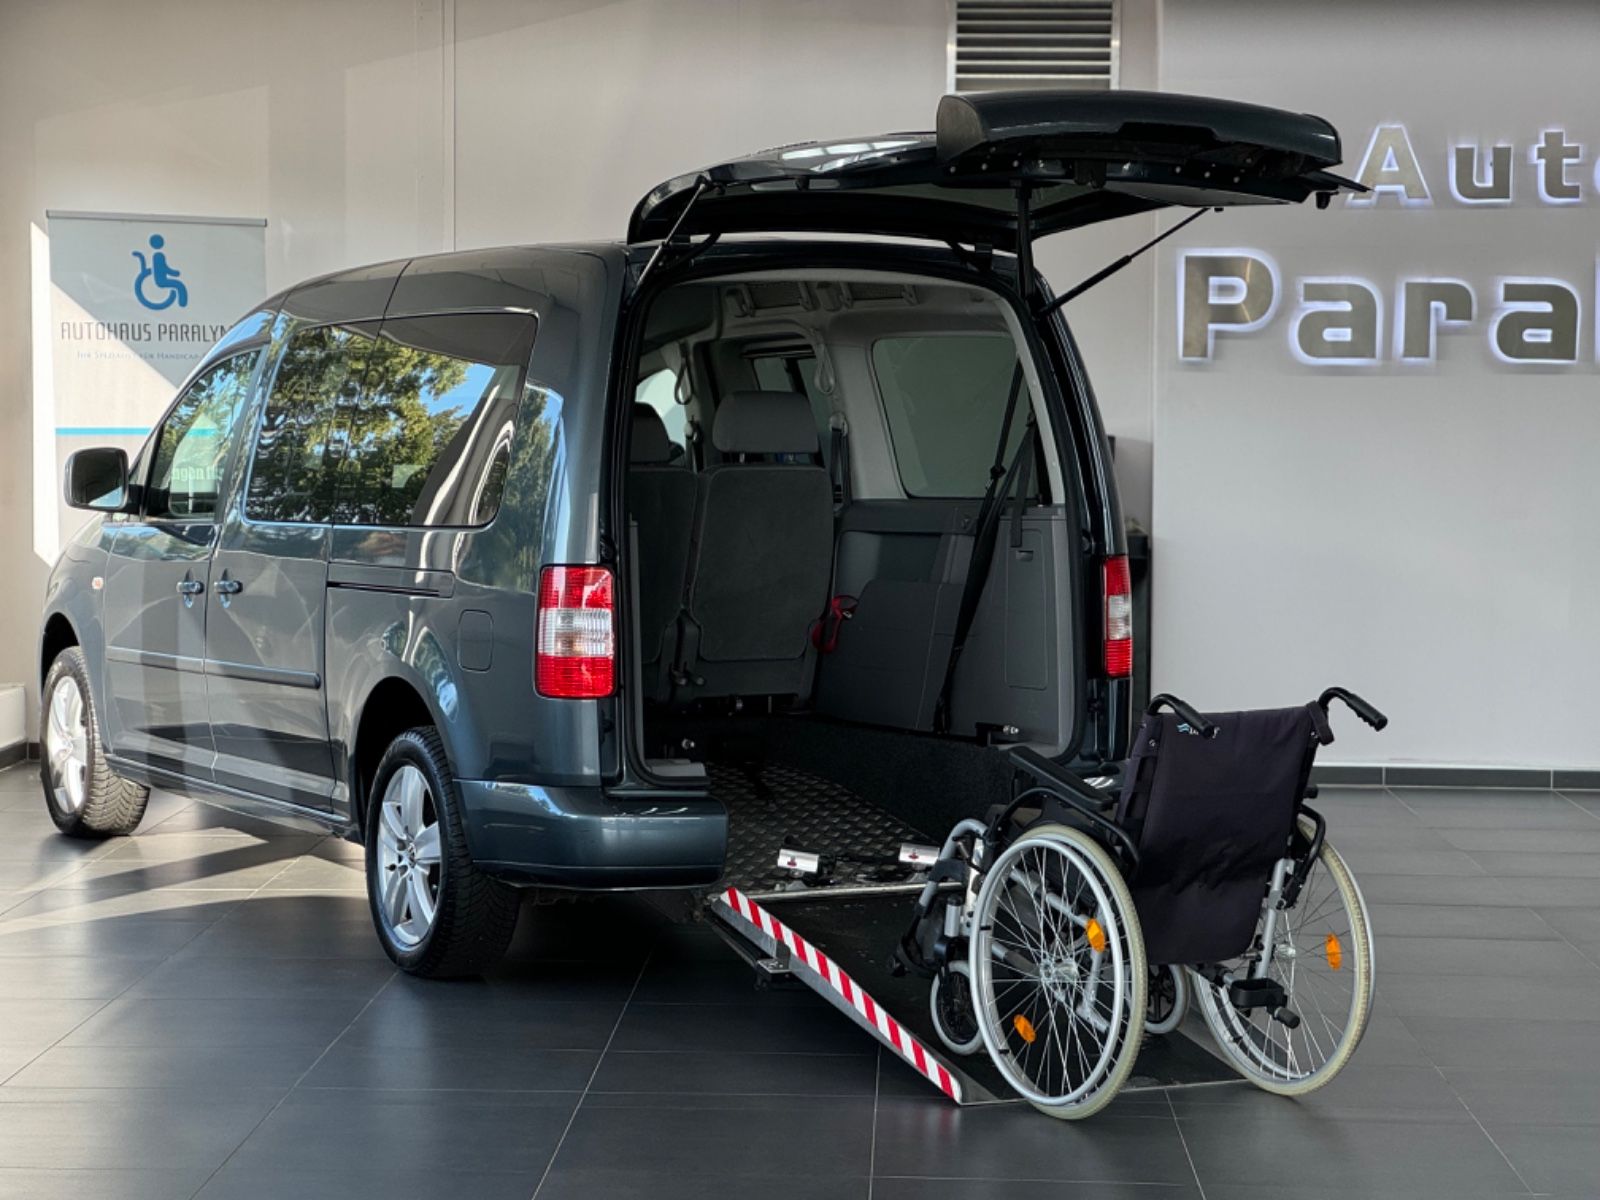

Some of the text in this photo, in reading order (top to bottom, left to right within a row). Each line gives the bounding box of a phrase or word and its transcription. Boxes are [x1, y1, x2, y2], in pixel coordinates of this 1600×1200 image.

[1345, 124, 1600, 203] Aut
[61, 321, 151, 341] AUTOHAUS
[1177, 250, 1600, 365] Para
